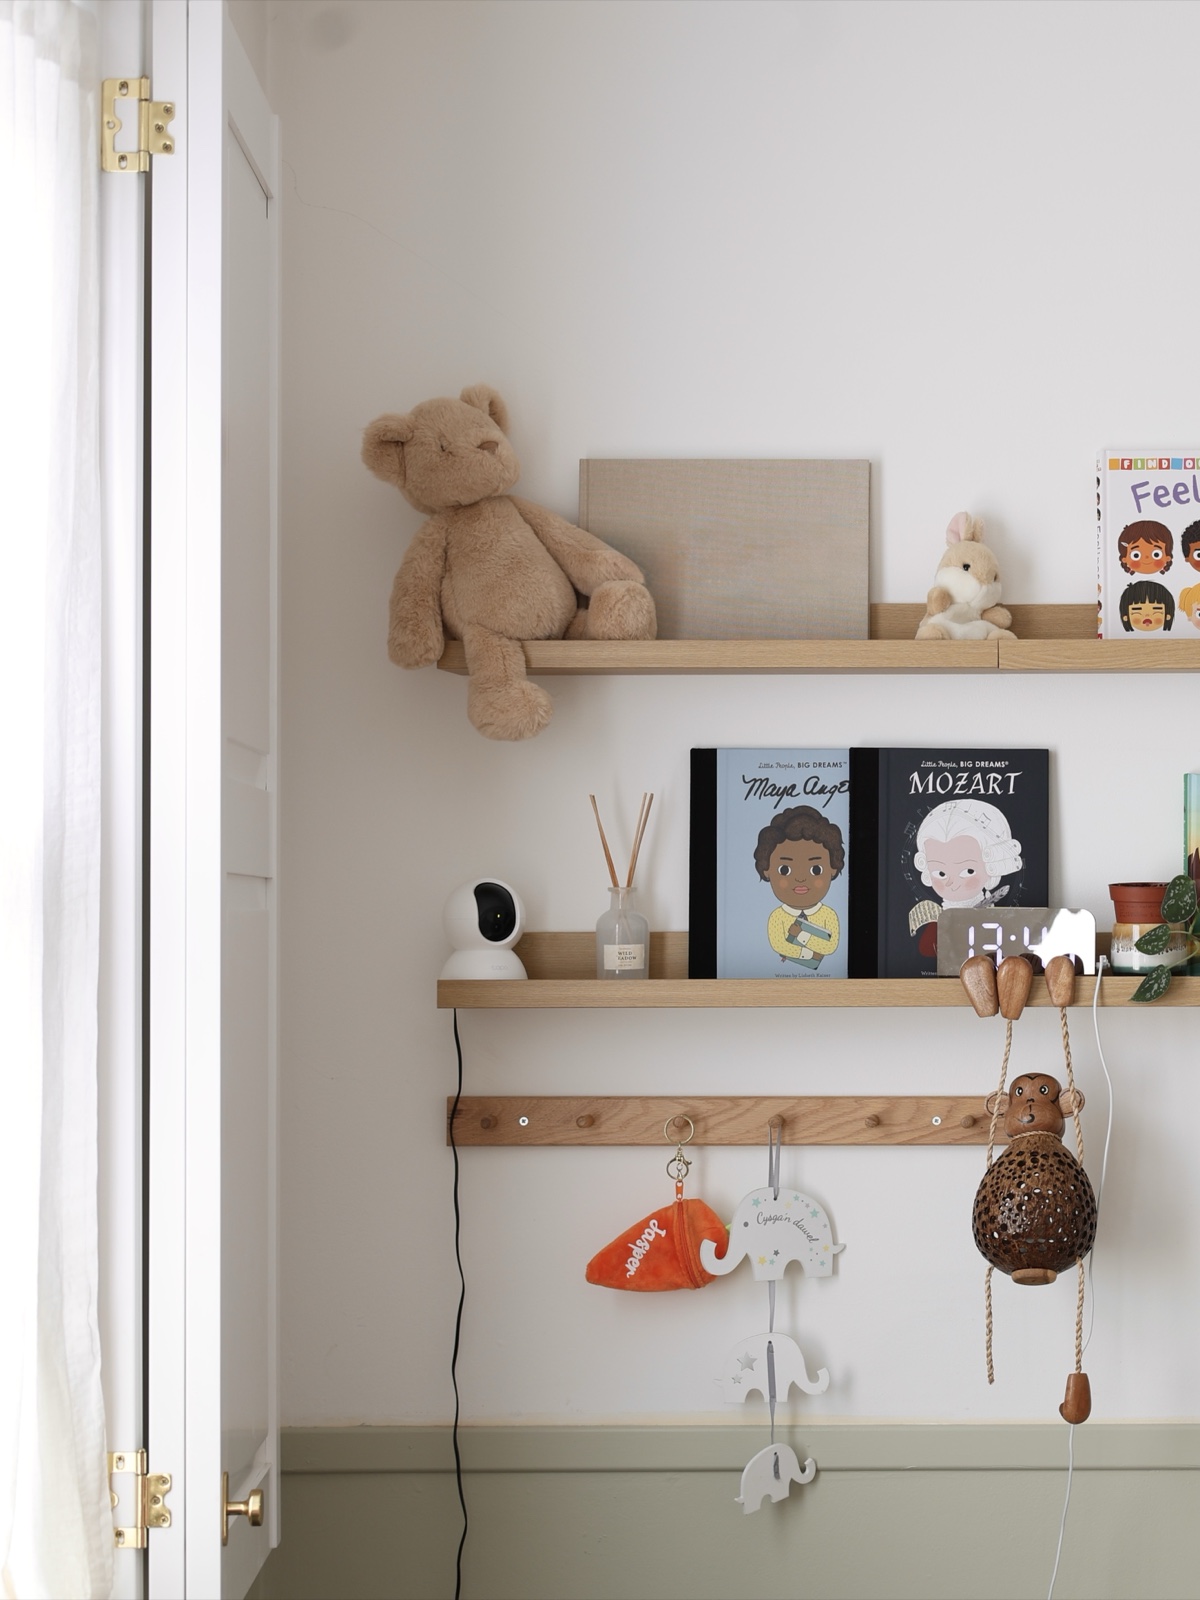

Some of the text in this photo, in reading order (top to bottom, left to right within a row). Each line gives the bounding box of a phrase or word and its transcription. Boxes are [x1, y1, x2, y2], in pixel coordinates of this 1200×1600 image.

[1122, 458, 1169, 469] FIND
[742, 774, 800, 809] Maya
[909, 771, 1023, 795] MOZART
[792, 1218, 820, 1243] dawel
[624, 1219, 667, 1279] Jasper
